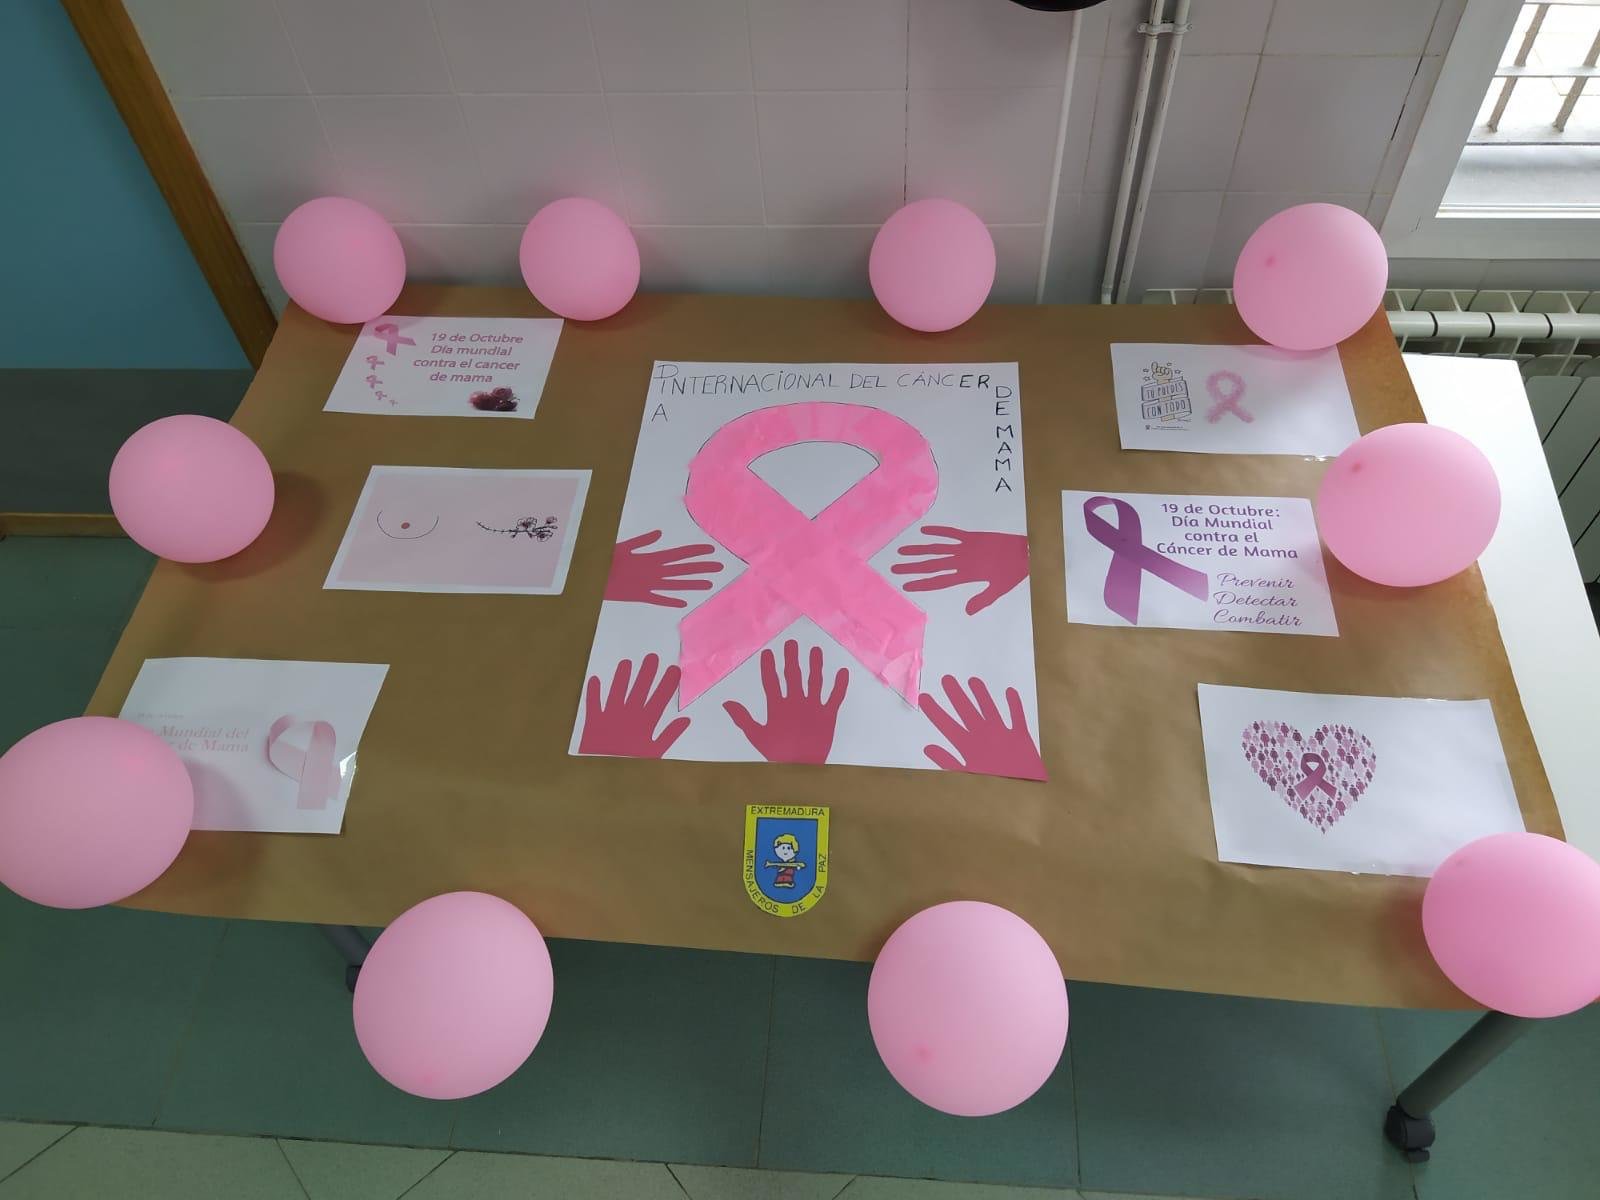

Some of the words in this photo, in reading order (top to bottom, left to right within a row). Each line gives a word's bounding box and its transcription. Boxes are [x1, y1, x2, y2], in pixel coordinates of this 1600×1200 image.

[431, 333, 447, 342] 19
[449, 333, 466, 342] de
[470, 333, 524, 344] Octubre
[456, 346, 513, 356] mundial
[413, 359, 456, 368] contra
[459, 359, 473, 368] el
[475, 360, 521, 370] cancer
[430, 372, 447, 381] de
[450, 373, 493, 383] mama
[849, 373, 887, 389] DEL
[995, 385, 1013, 416] DE
[994, 424, 1014, 492] MAMA
[1160, 503, 1178, 513] 19
[1184, 504, 1203, 514] de
[1209, 504, 1280, 517] Octubre:
[1172, 515, 1199, 527] Día
[1205, 517, 1274, 530] Mundial
[1184, 531, 1238, 542] contra
[1244, 532, 1260, 543] el
[1157, 542, 1213, 555] Cáncer
[1218, 545, 1238, 556] de
[1244, 546, 1299, 559] Mama
[1216, 572, 1295, 588] Prevenir
[1213, 591, 1298, 607] Detectar
[1213, 608, 1303, 626] Combatir
[751, 805, 825, 816] EXTREMADURA
[818, 854, 827, 873] PAZ
[745, 849, 779, 913] MENSAJEROS
[813, 885, 824, 898] LA
[791, 903, 806, 914] DE
